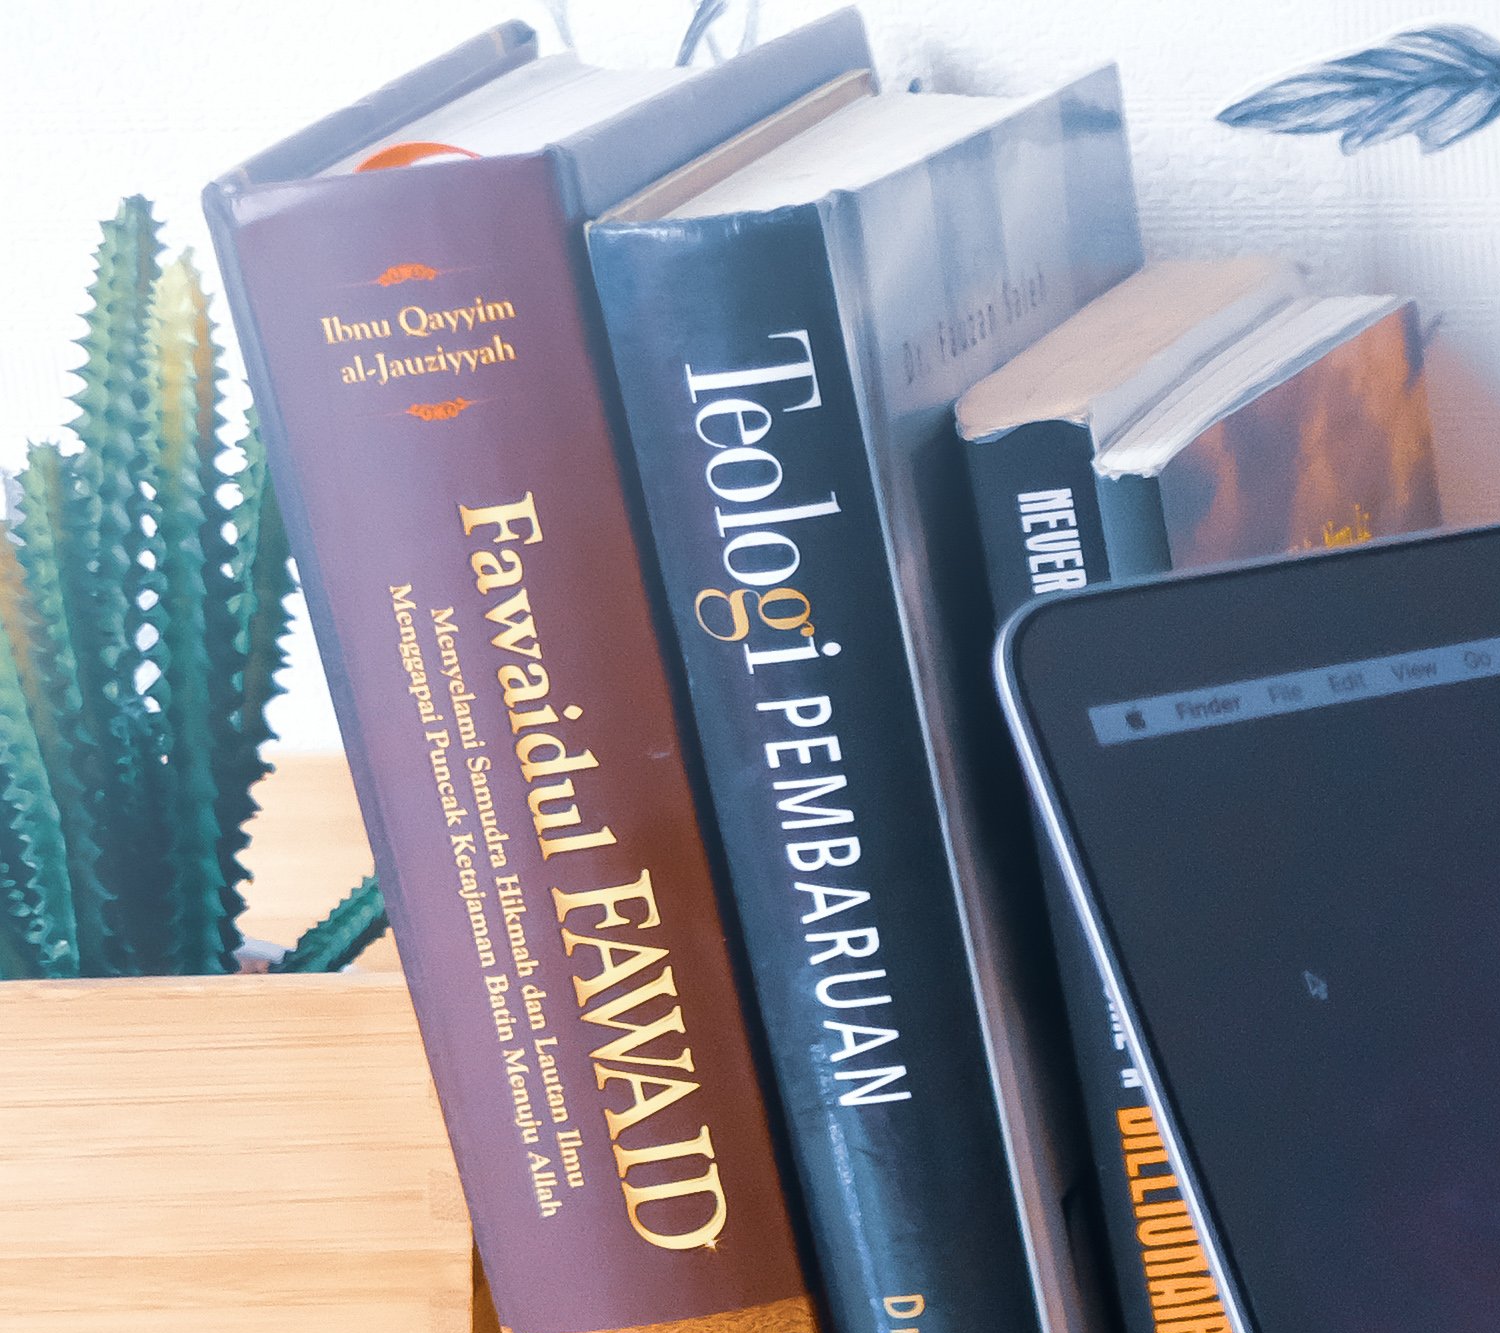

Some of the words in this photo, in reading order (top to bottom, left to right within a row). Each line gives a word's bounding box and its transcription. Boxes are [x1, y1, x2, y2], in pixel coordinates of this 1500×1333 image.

[321, 314, 391, 344] Ibnu
[398, 296, 517, 338] Qayyim
[340, 335, 517, 385] al-Jauziyyah
[684, 328, 842, 674] Teologi
[1017, 487, 1088, 595] NEVER
[388, 584, 444, 724] Menggapai
[425, 729, 469, 827] Puncak
[450, 832, 496, 968] Ketajaman
[484, 974, 517, 1042] Batin
[502, 1047, 543, 1144] Menuju
[527, 1151, 563, 1218] Allah
[430, 606, 486, 750] Menyelami
[466, 756, 510, 869] Samudra
[495, 874, 539, 978] Hikmah
[521, 984, 547, 1030] dan
[534, 1036, 569, 1123] Lautan
[556, 1129, 585, 1188] Ilmu
[460, 491, 617, 860] Fawaidul
[551, 868, 727, 1250] FAWAID
[755, 695, 912, 1107] PEMBARUAN
